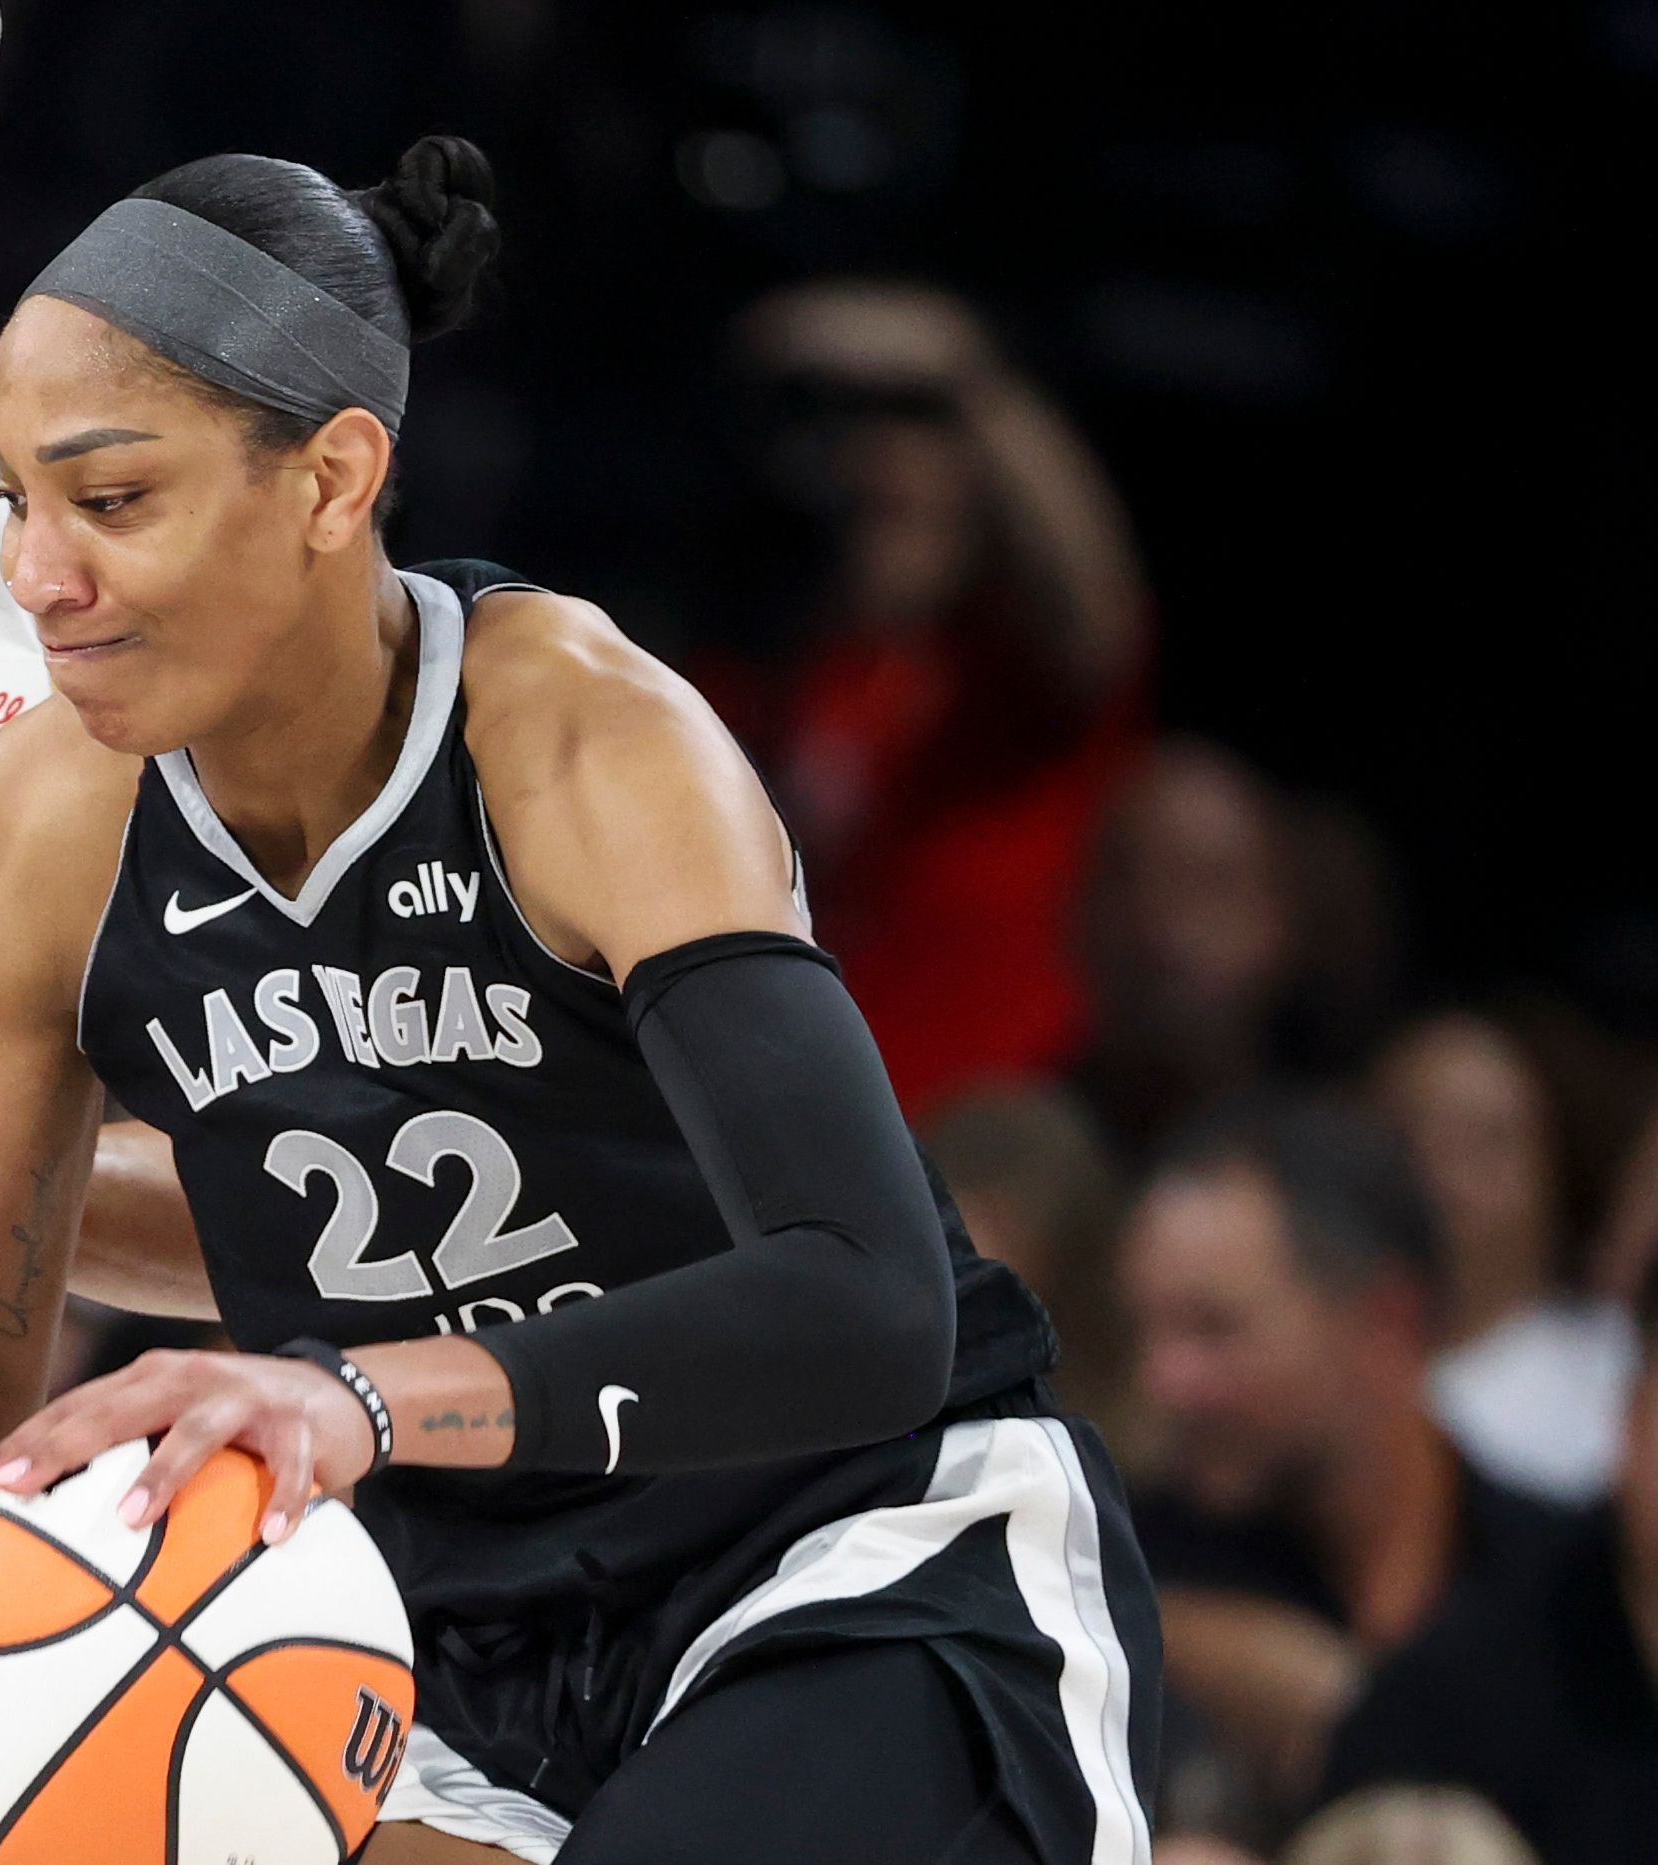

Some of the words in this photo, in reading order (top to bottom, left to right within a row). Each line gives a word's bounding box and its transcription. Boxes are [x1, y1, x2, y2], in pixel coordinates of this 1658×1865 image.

[388, 861, 480, 922] ally
[146, 968, 320, 1112] LAS
[311, 965, 542, 1068] VEGAS
[263, 1110, 579, 1301] 22
